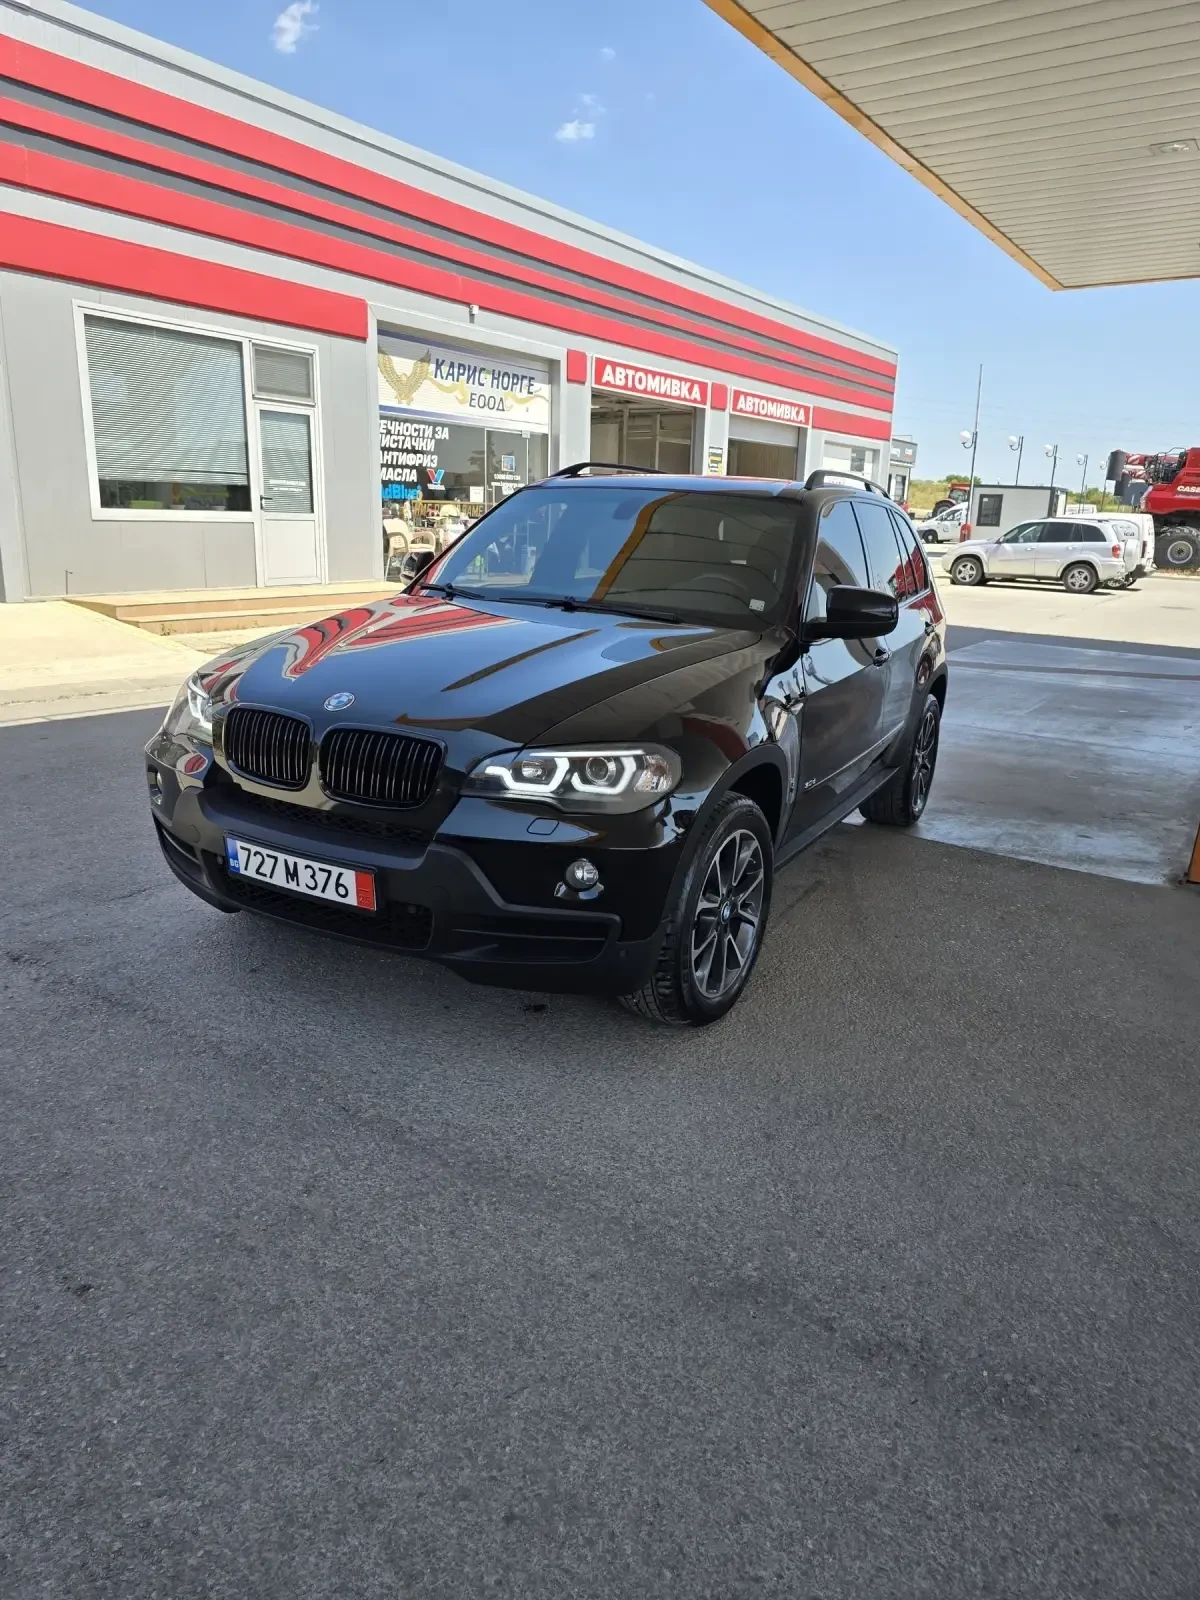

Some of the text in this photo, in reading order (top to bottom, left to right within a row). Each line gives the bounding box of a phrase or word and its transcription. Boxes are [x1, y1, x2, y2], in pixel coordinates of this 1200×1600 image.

[434, 358, 536, 395] КАРИС НОРГЕ
[601, 364, 702, 402] АВТОМИВКА
[469, 392, 505, 412] ЕООД
[736, 394, 806, 423] АВТОМИВКА
[379, 420, 449, 439] ЕЧНОСТИ ЗА
[379, 434, 436, 452] ИСТАЧКИ
[230, 858, 239, 868] BG
[240, 846, 349, 898] 727 M 376
